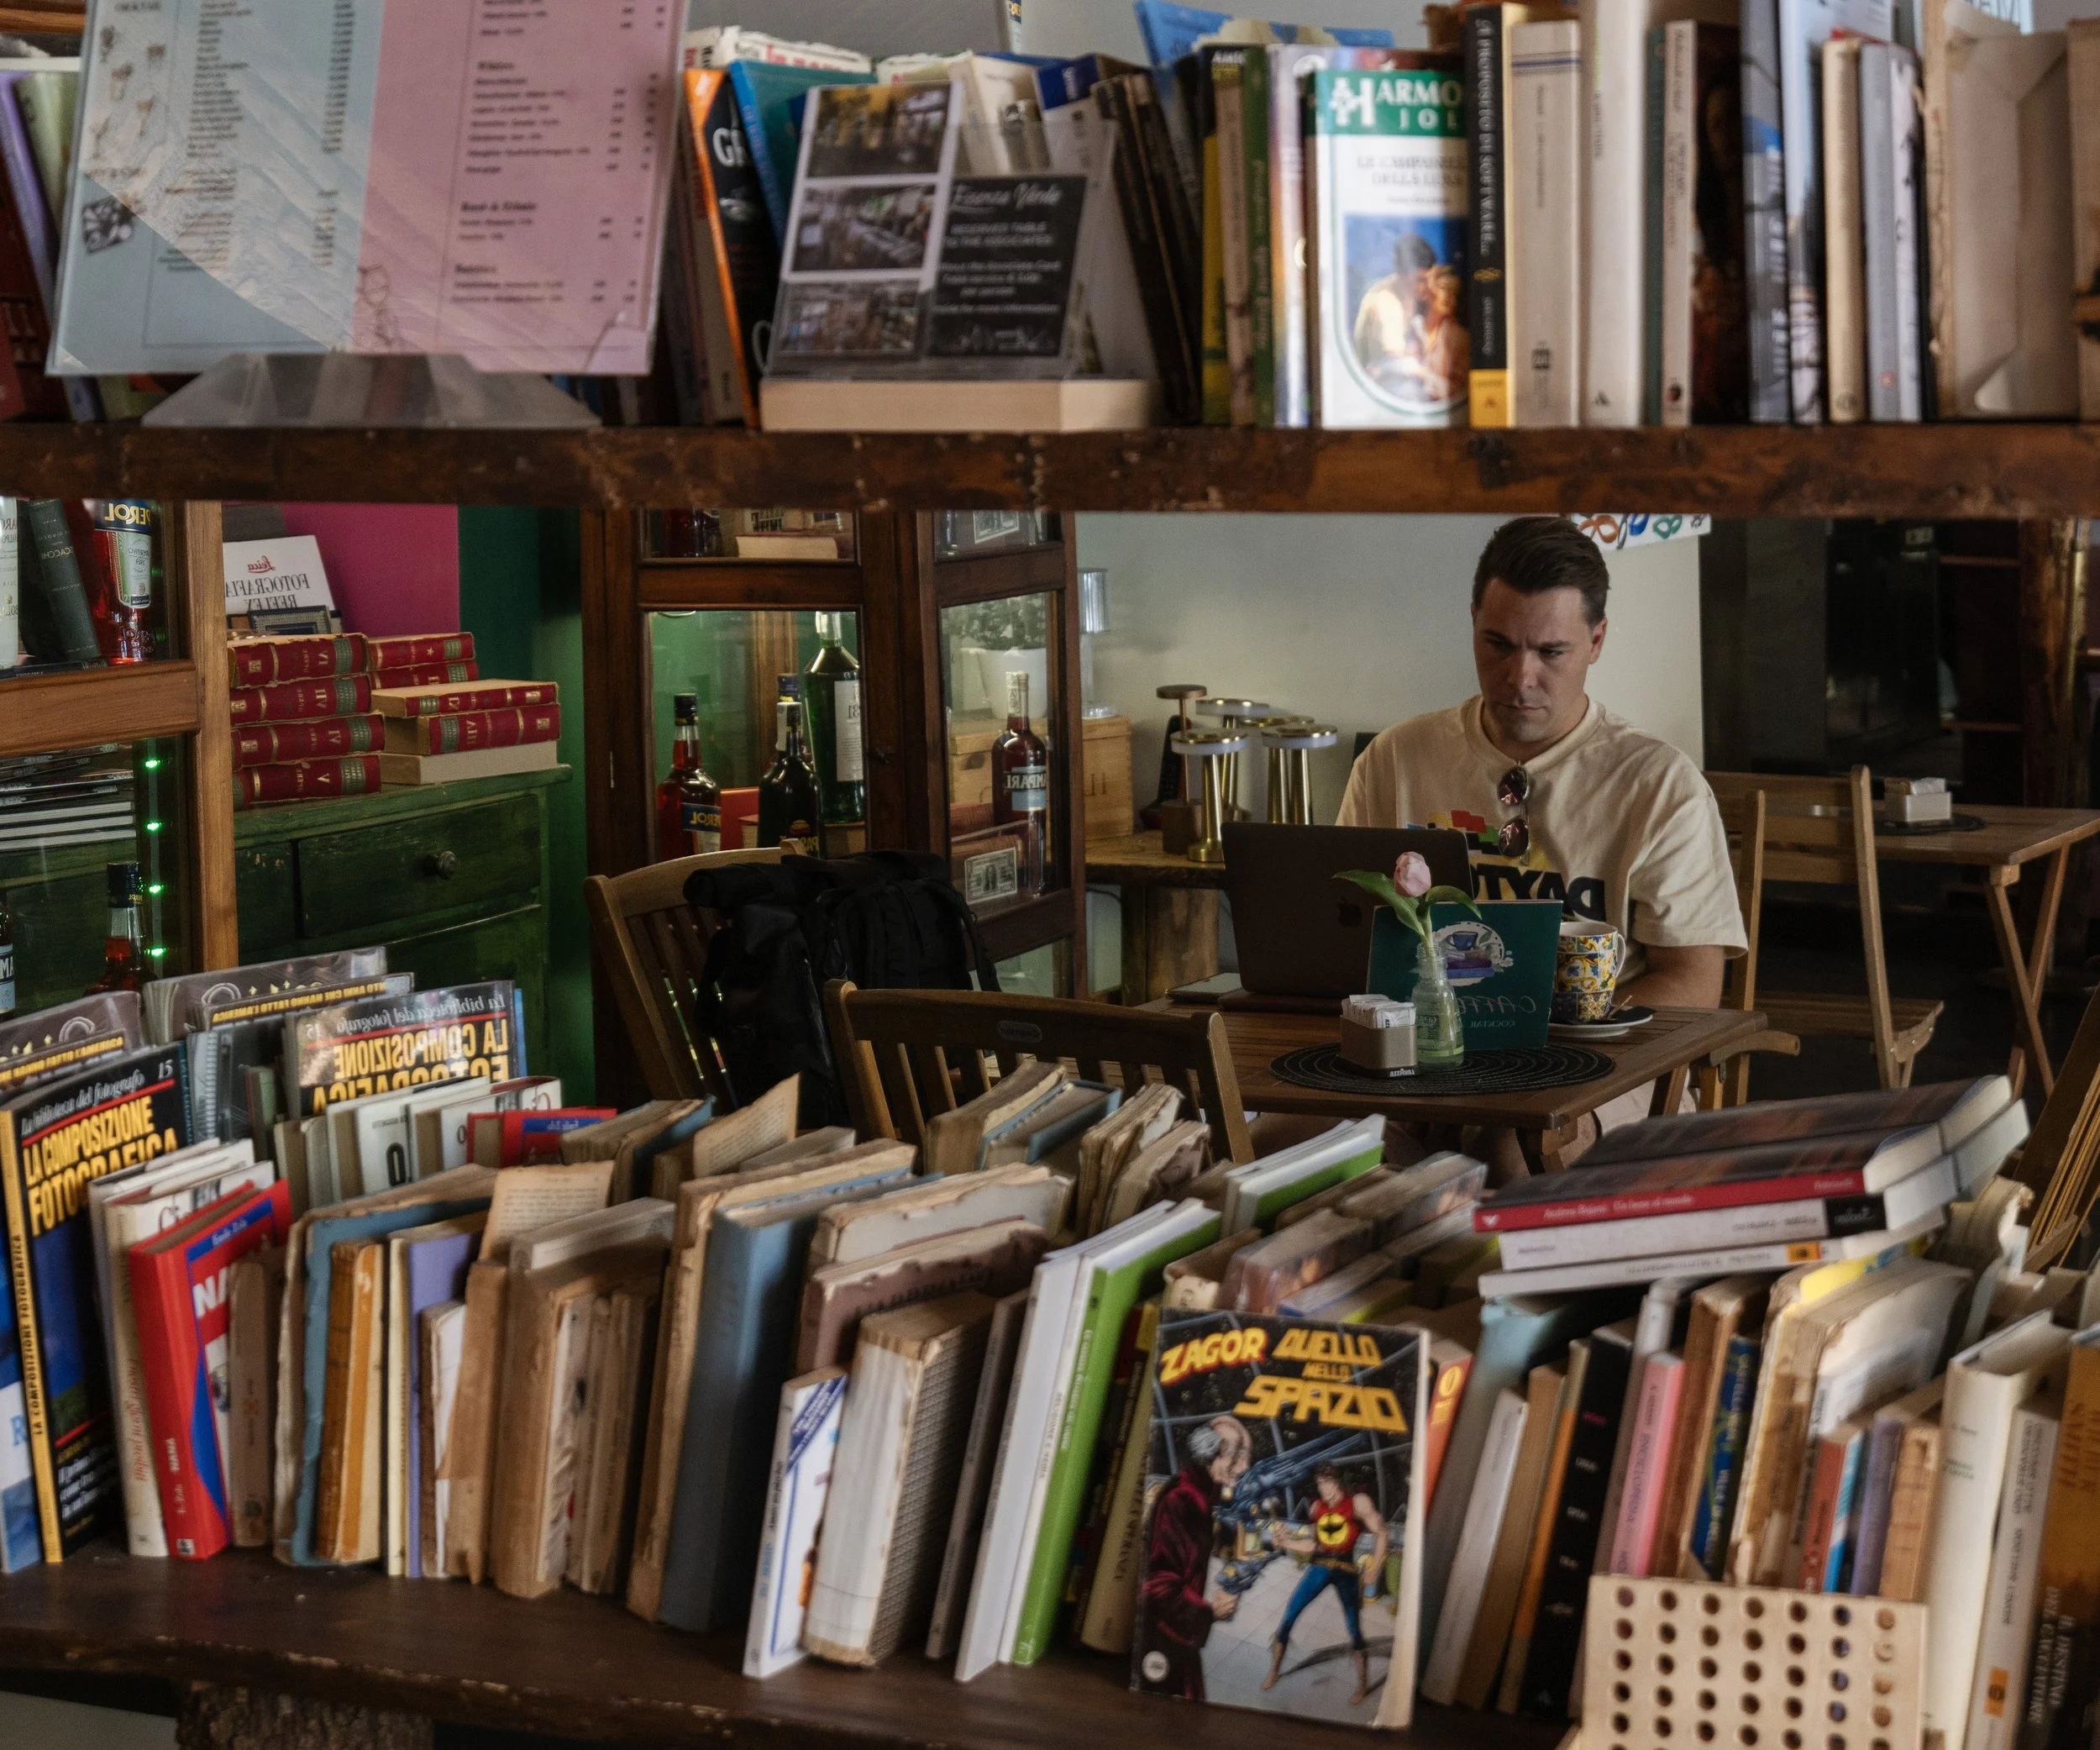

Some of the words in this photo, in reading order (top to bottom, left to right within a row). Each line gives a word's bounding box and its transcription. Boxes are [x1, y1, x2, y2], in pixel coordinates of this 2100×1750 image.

[1477, 38, 1496, 129] PROPOSITO
[1478, 134, 1495, 152] DI
[76, 1085, 92, 1108] del
[93, 1069, 145, 1106] fotografo
[158, 1059, 173, 1080] 15
[23, 1143, 43, 1186] LA
[41, 1095, 155, 1176] COMPOSIZIONE
[11, 1233, 30, 1318] FOTOGRAFICA
[21, 1323, 40, 1416] COMPOSIZIONE
[1160, 1327, 1268, 1385] ZAGOR
[1271, 1327, 1383, 1367] DUELLO
[1301, 1361, 1354, 1382] NELLO
[1233, 1375, 1409, 1433] SPAZIO
[164, 1437, 180, 1473] NANA
[2026, 1622, 2055, 1724] CACCIATORE
[2046, 1634, 2073, 1708] DESTINO
